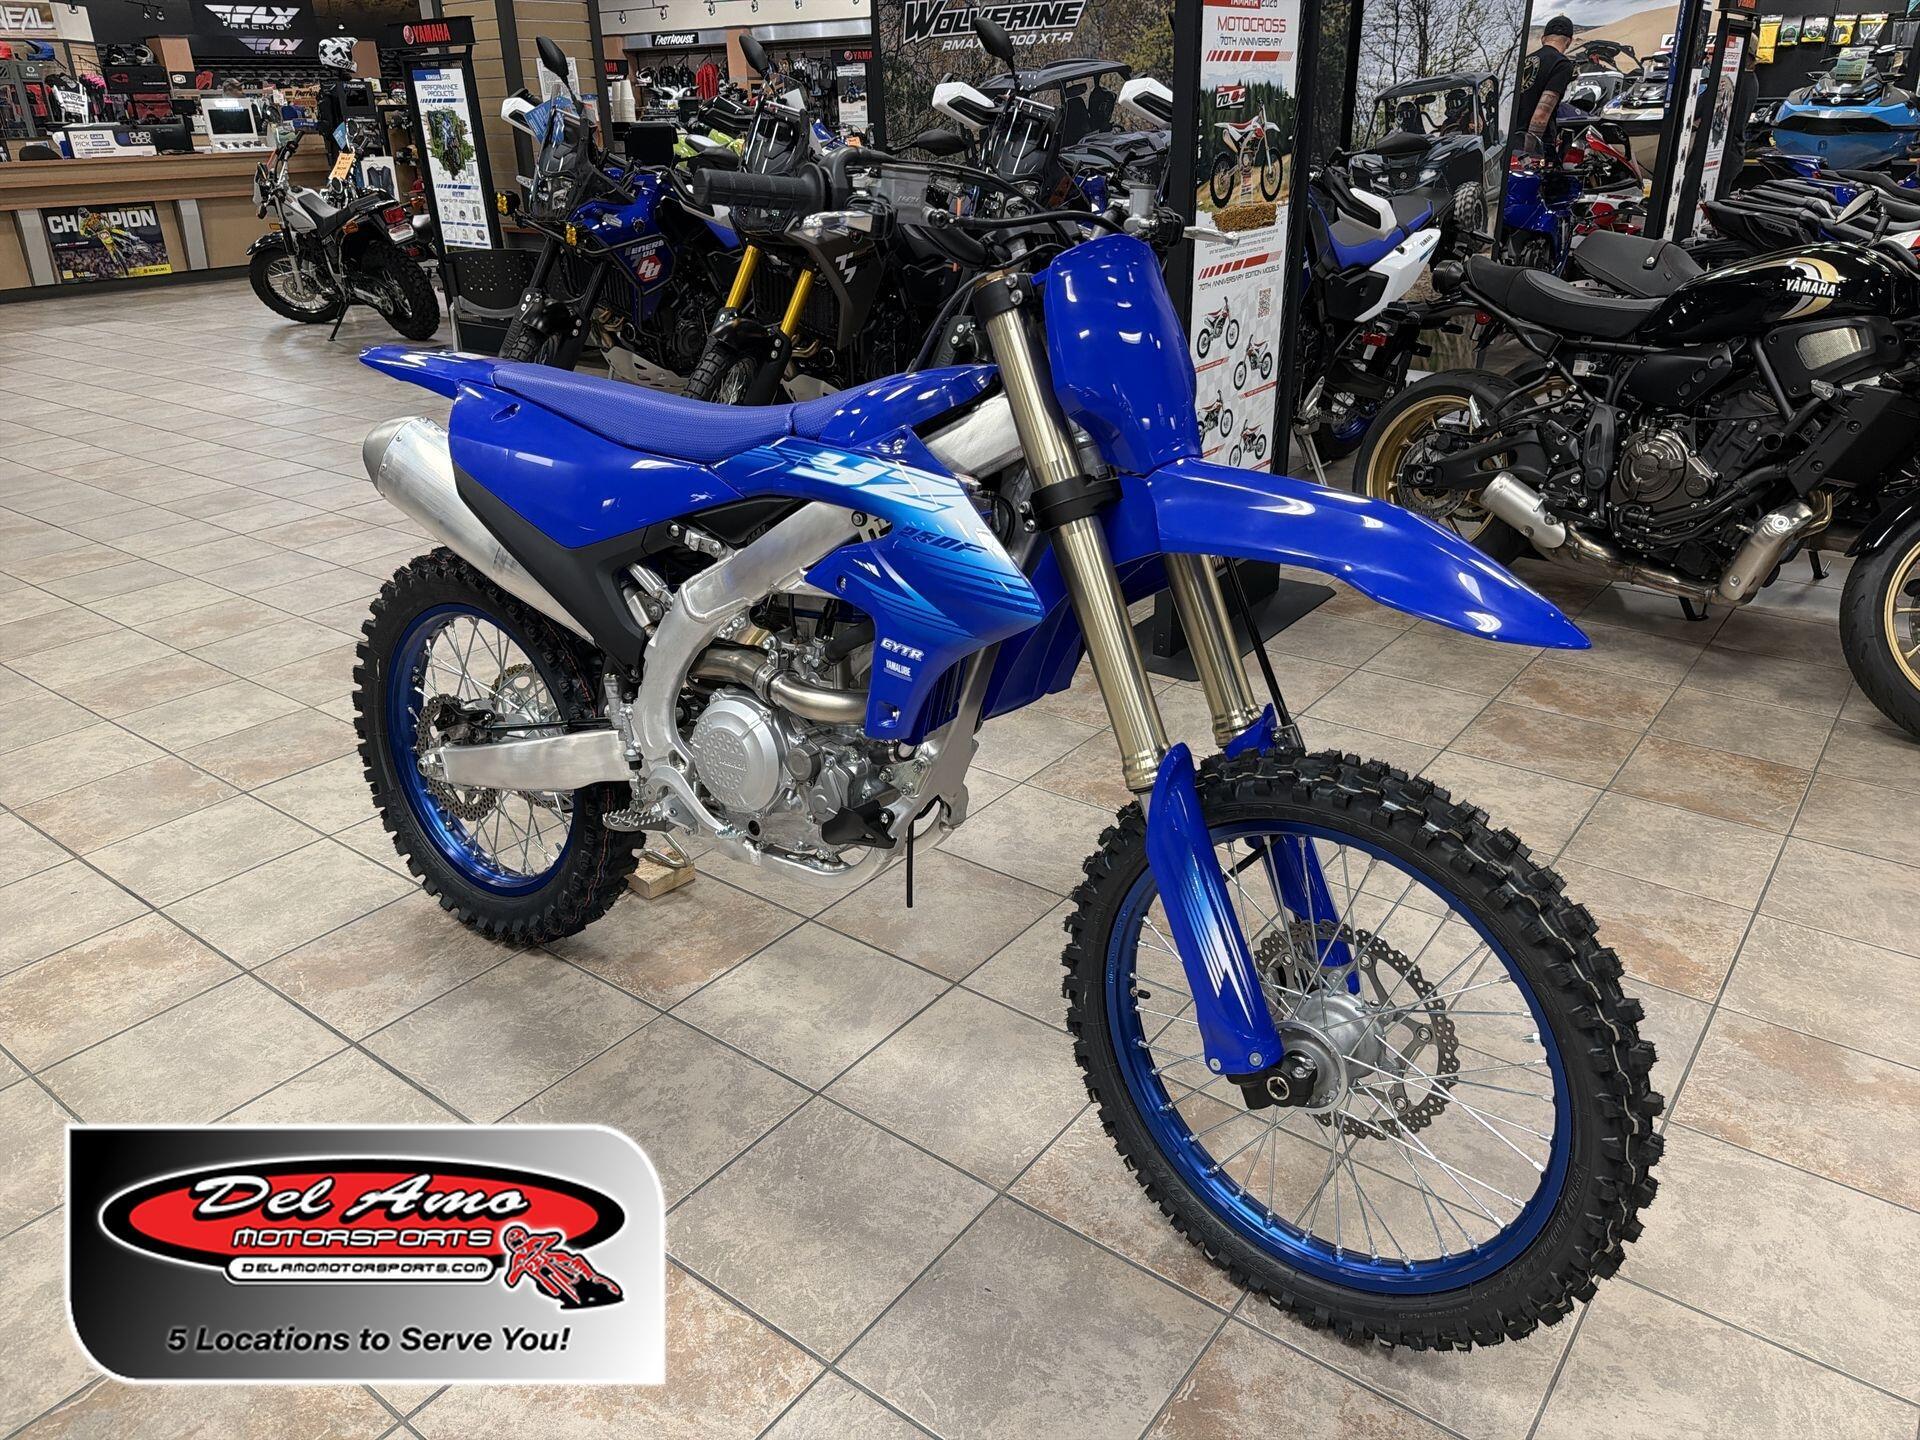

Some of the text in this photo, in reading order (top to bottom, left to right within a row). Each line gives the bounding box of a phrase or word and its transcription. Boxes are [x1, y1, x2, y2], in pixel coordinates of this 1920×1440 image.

[204, 4, 301, 24] FLY
[903, 0, 1086, 44] WOLVERINE
[412, 23, 451, 43] YAMAHA
[1217, 16, 1287, 33] MOTOCROSS
[238, 37, 304, 51] FLY
[655, 33, 696, 46] FASTHOUSE
[942, 40, 985, 51] RMAX
[1038, 32, 1074, 44] XT-R
[1220, 36, 1283, 46] 70TH ANNIVERSARY
[853, 51, 873, 60] YAMA
[47, 209, 157, 234] CHPION
[1199, 264, 1280, 291] 70TH ANNIVERSARY EDITION MODELS
[1786, 278, 1837, 297] YAMAHA
[880, 637, 925, 662] GYTR
[885, 658, 912, 677] YAMALUBE
